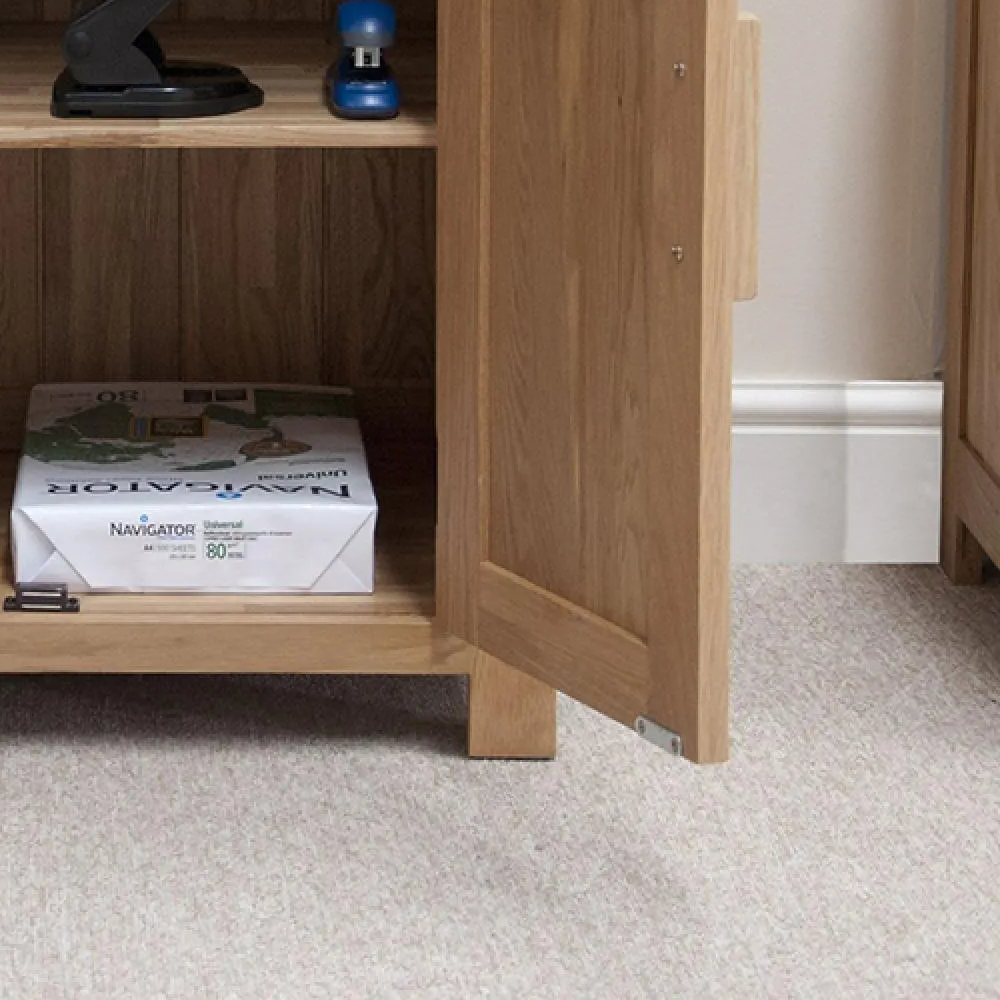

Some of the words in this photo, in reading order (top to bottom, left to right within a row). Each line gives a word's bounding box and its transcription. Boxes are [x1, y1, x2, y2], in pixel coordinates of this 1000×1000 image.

[257, 469, 348, 481] Universal
[46, 482, 350, 499] NAVIGATOR
[203, 519, 243, 529] Universal
[206, 542, 227, 559] 80
